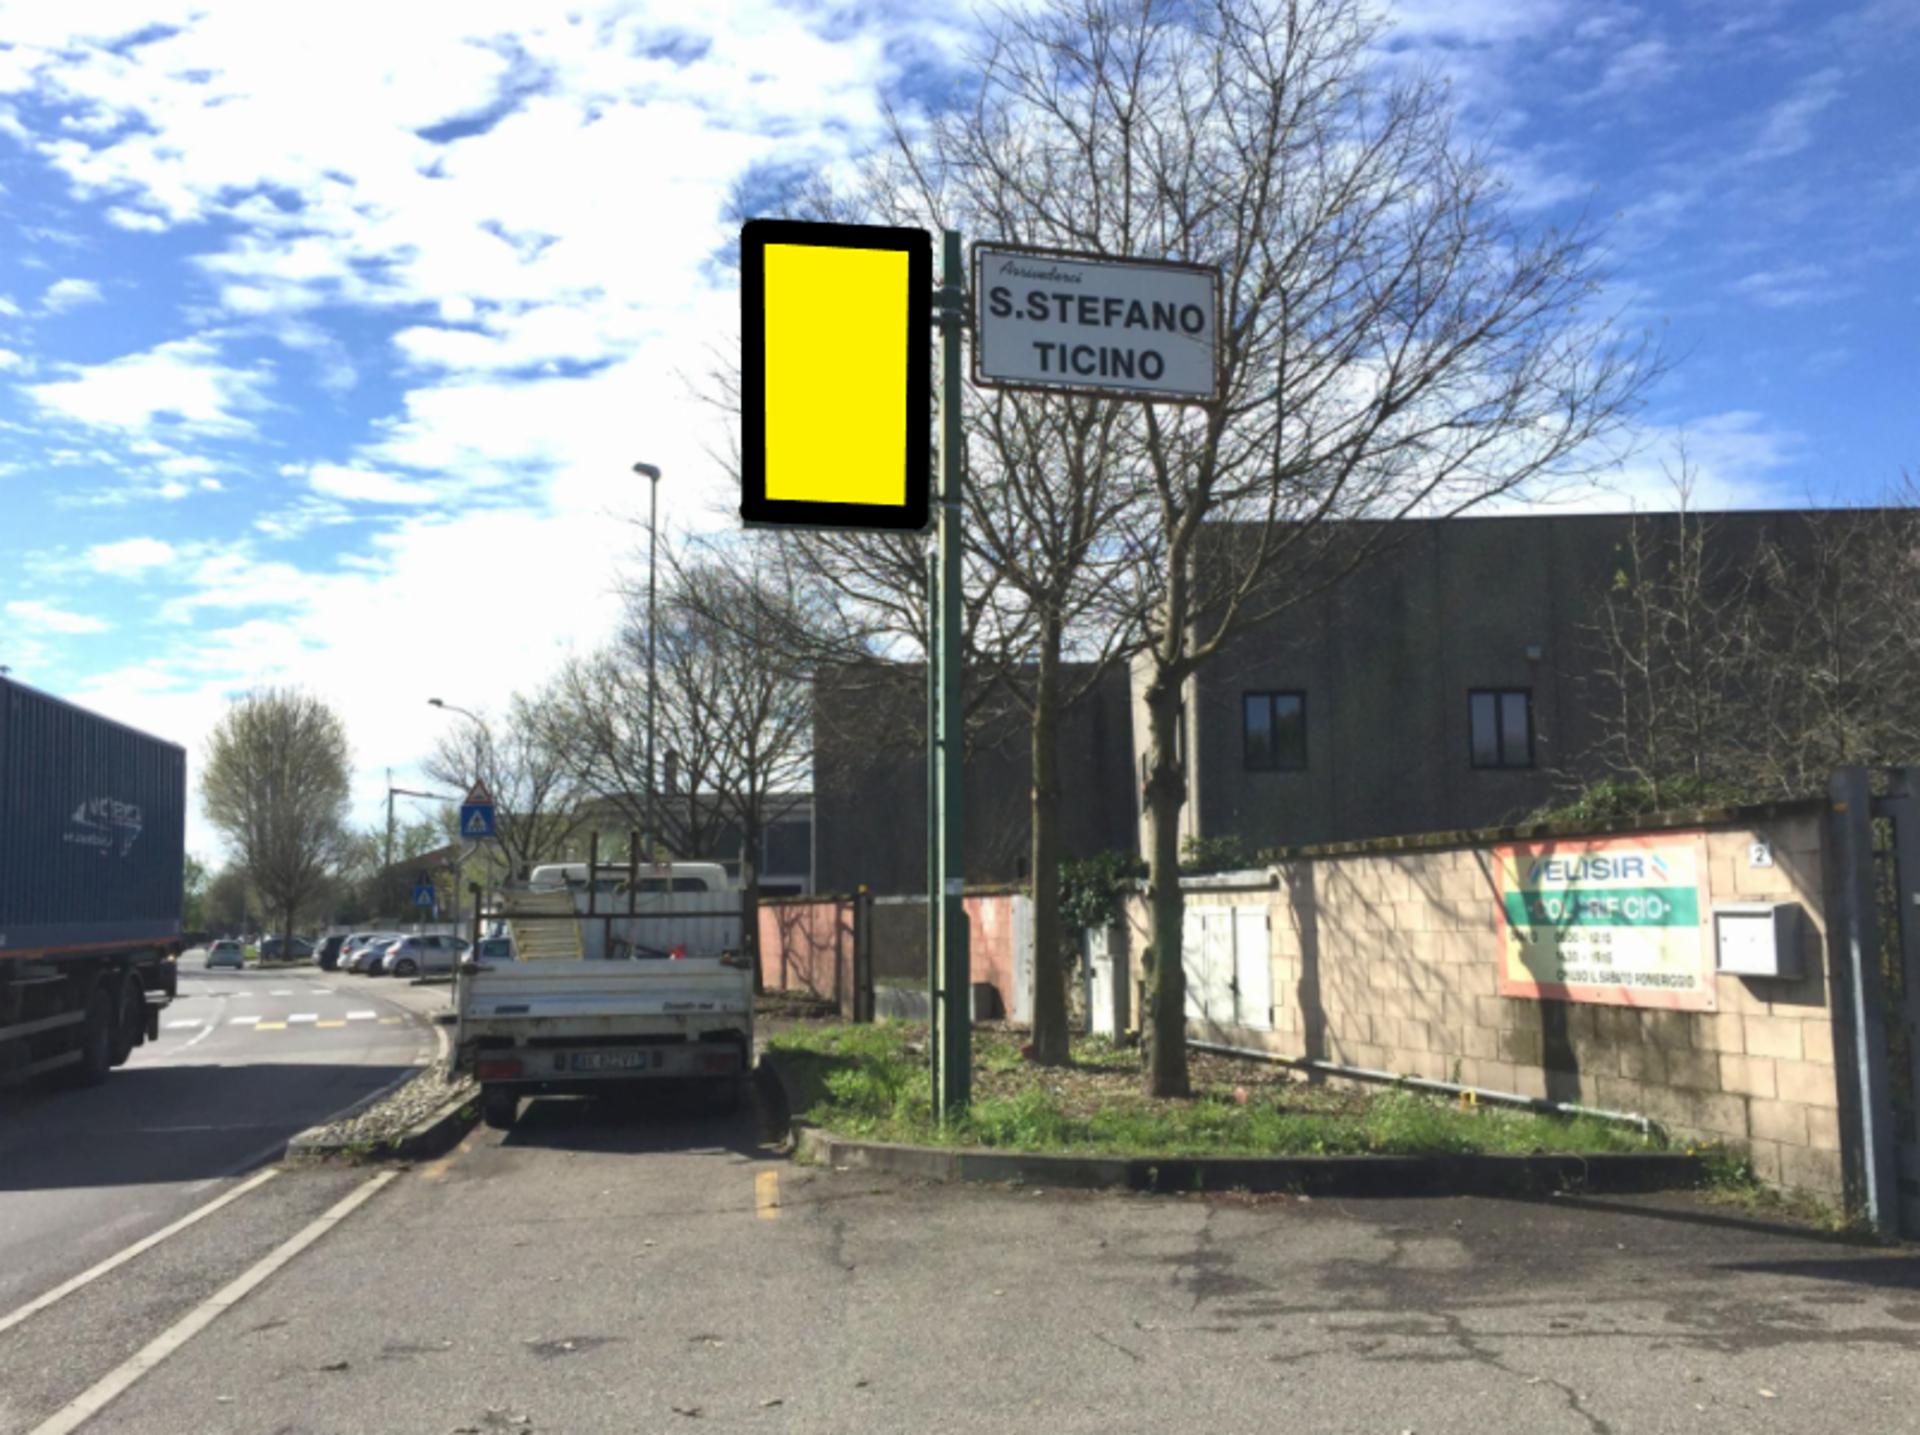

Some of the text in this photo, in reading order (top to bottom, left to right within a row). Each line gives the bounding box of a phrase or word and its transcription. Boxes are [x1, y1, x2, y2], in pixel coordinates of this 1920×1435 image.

[988, 286, 1205, 334] S.STEFANO
[1032, 341, 1165, 381] TICINO
[1544, 856, 1644, 881] ELISIR
